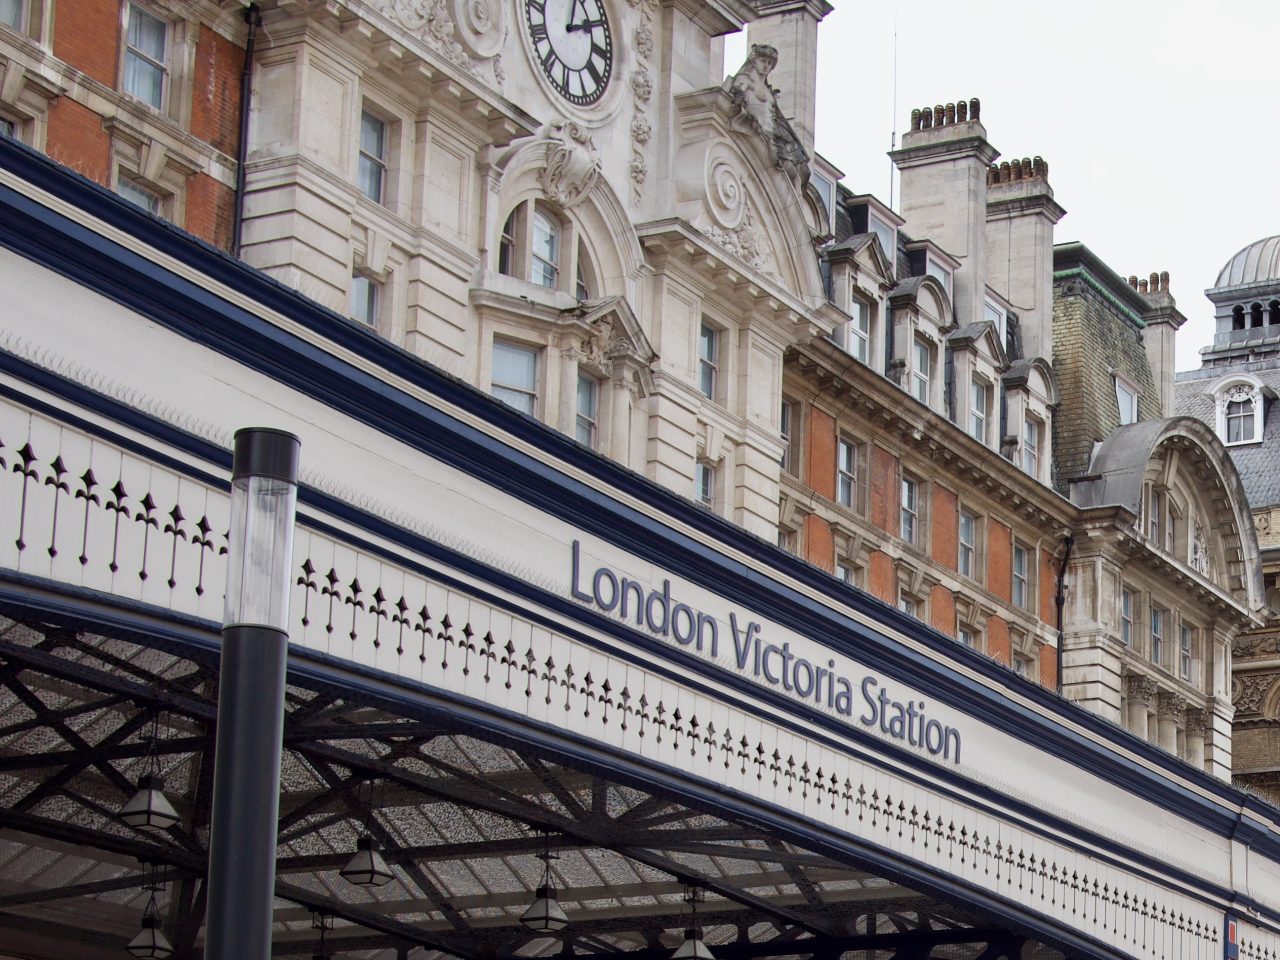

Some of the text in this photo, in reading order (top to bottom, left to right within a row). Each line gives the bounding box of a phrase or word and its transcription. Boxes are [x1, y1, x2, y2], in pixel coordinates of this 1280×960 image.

[571, 539, 961, 764] London Victoria Station
